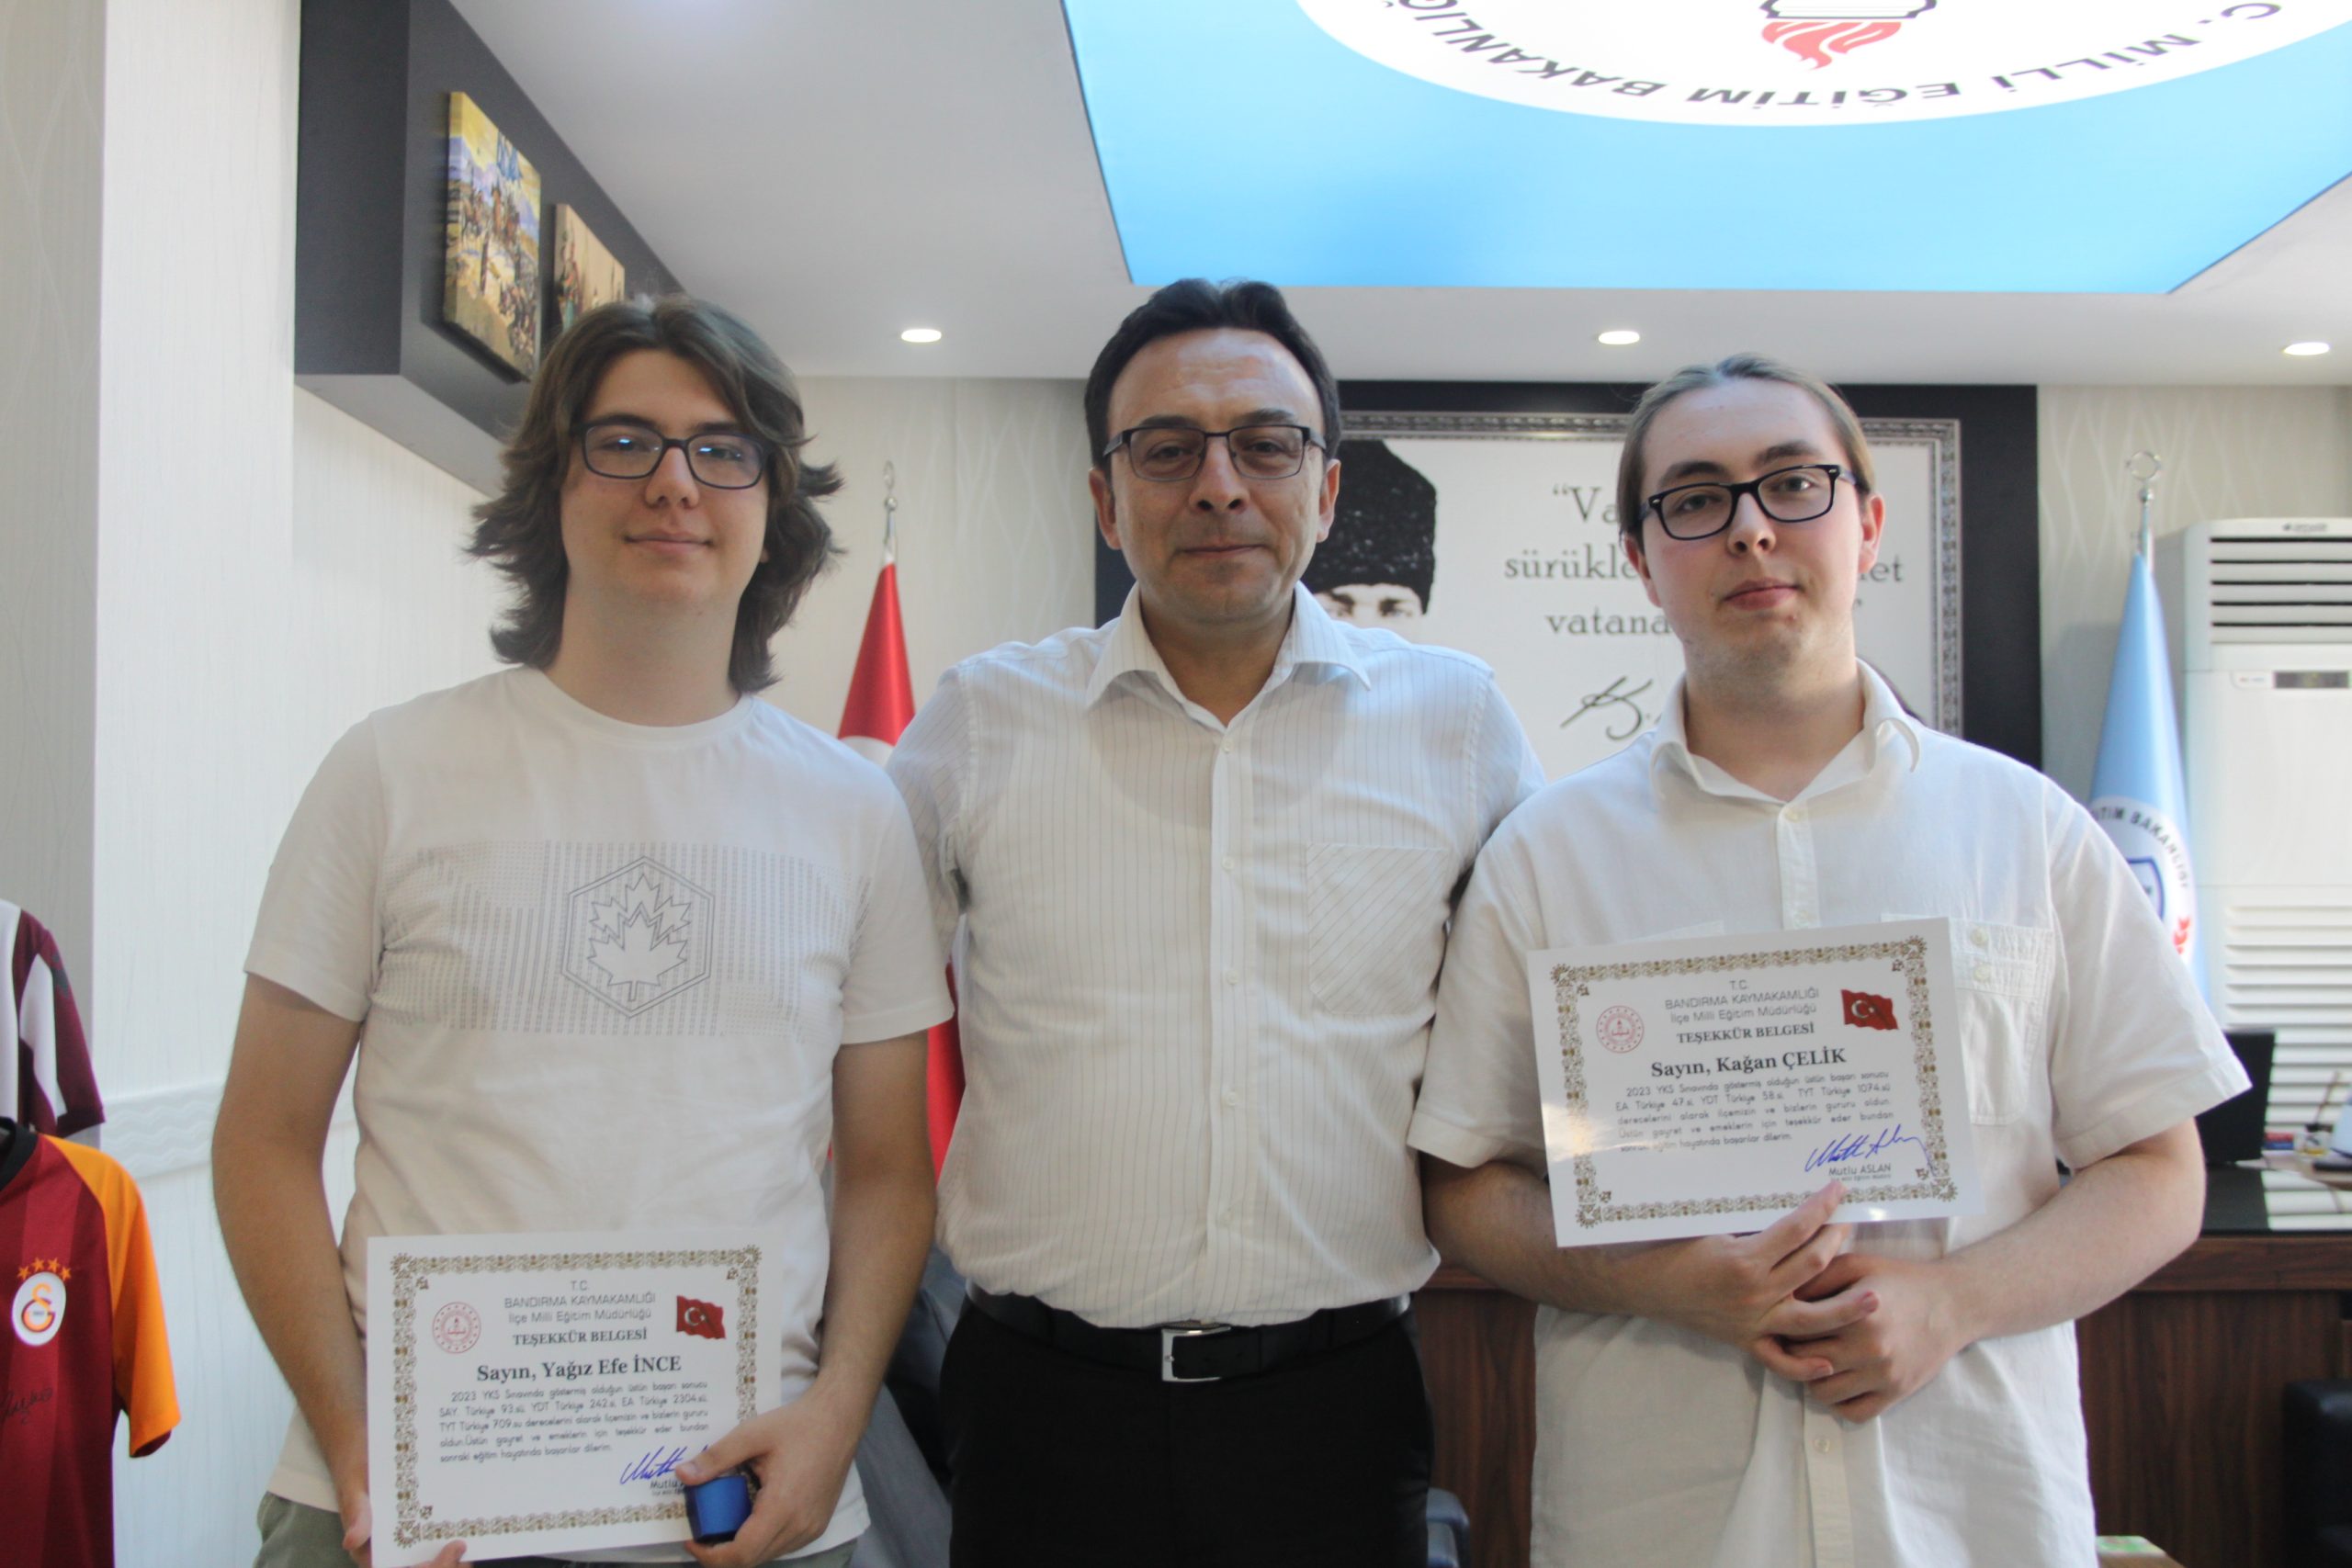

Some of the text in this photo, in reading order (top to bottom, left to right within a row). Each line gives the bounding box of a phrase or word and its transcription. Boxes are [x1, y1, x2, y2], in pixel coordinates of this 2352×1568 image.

[1990, 34, 2201, 93] MİLLİ
[1686, 83, 1962, 109] EĞİTİM
[1665, 987, 1819, 1010] BANDIRMA KAYMAKAMLIĞI
[1719, 1009, 1754, 1021] Eğitim
[1758, 1003, 1816, 1017] Müdürlüğü
[1677, 1021, 1815, 1044] TEŞEKKÜR BELGESİ
[1651, 1045, 1847, 1078] Sayın, Kağan ÇELİK
[1615, 1101, 1629, 1111] EA
[1635, 1100, 1666, 1112] Türkiye
[1701, 1094, 1718, 1105] YDT
[1725, 1092, 1756, 1106] Türkiye
[1798, 1087, 1814, 1098] TYT
[1821, 1086, 1851, 1099] Türkiye
[1626, 1087, 1651, 1098] 2023
[1656, 1084, 1675, 1095] YKS
[1828, 1163, 1891, 1176] Mutlu ASLAN
[504, 1291, 656, 1309] BANDIRMA KAYMAKAMLIĞI
[556, 1310, 591, 1324] Eğitim
[594, 1307, 651, 1321] Müdürlüğü
[513, 1326, 648, 1347] TEŞEKKÜR BELGESİ
[477, 1354, 682, 1384] Sayın, Yağız Efe İNCE
[451, 1390, 477, 1402] 2023
[483, 1389, 500, 1400] YKS
[439, 1406, 458, 1417] SAY
[466, 1405, 495, 1418] Türkiye
[531, 1401, 548, 1412] YDT
[555, 1400, 583, 1413] Türkiye
[621, 1396, 634, 1406] EA
[639, 1395, 668, 1408] Türkiye
[439, 1421, 456, 1432] TYT
[459, 1420, 489, 1434] Türkiye
[650, 1479, 678, 1489] Mutlu
